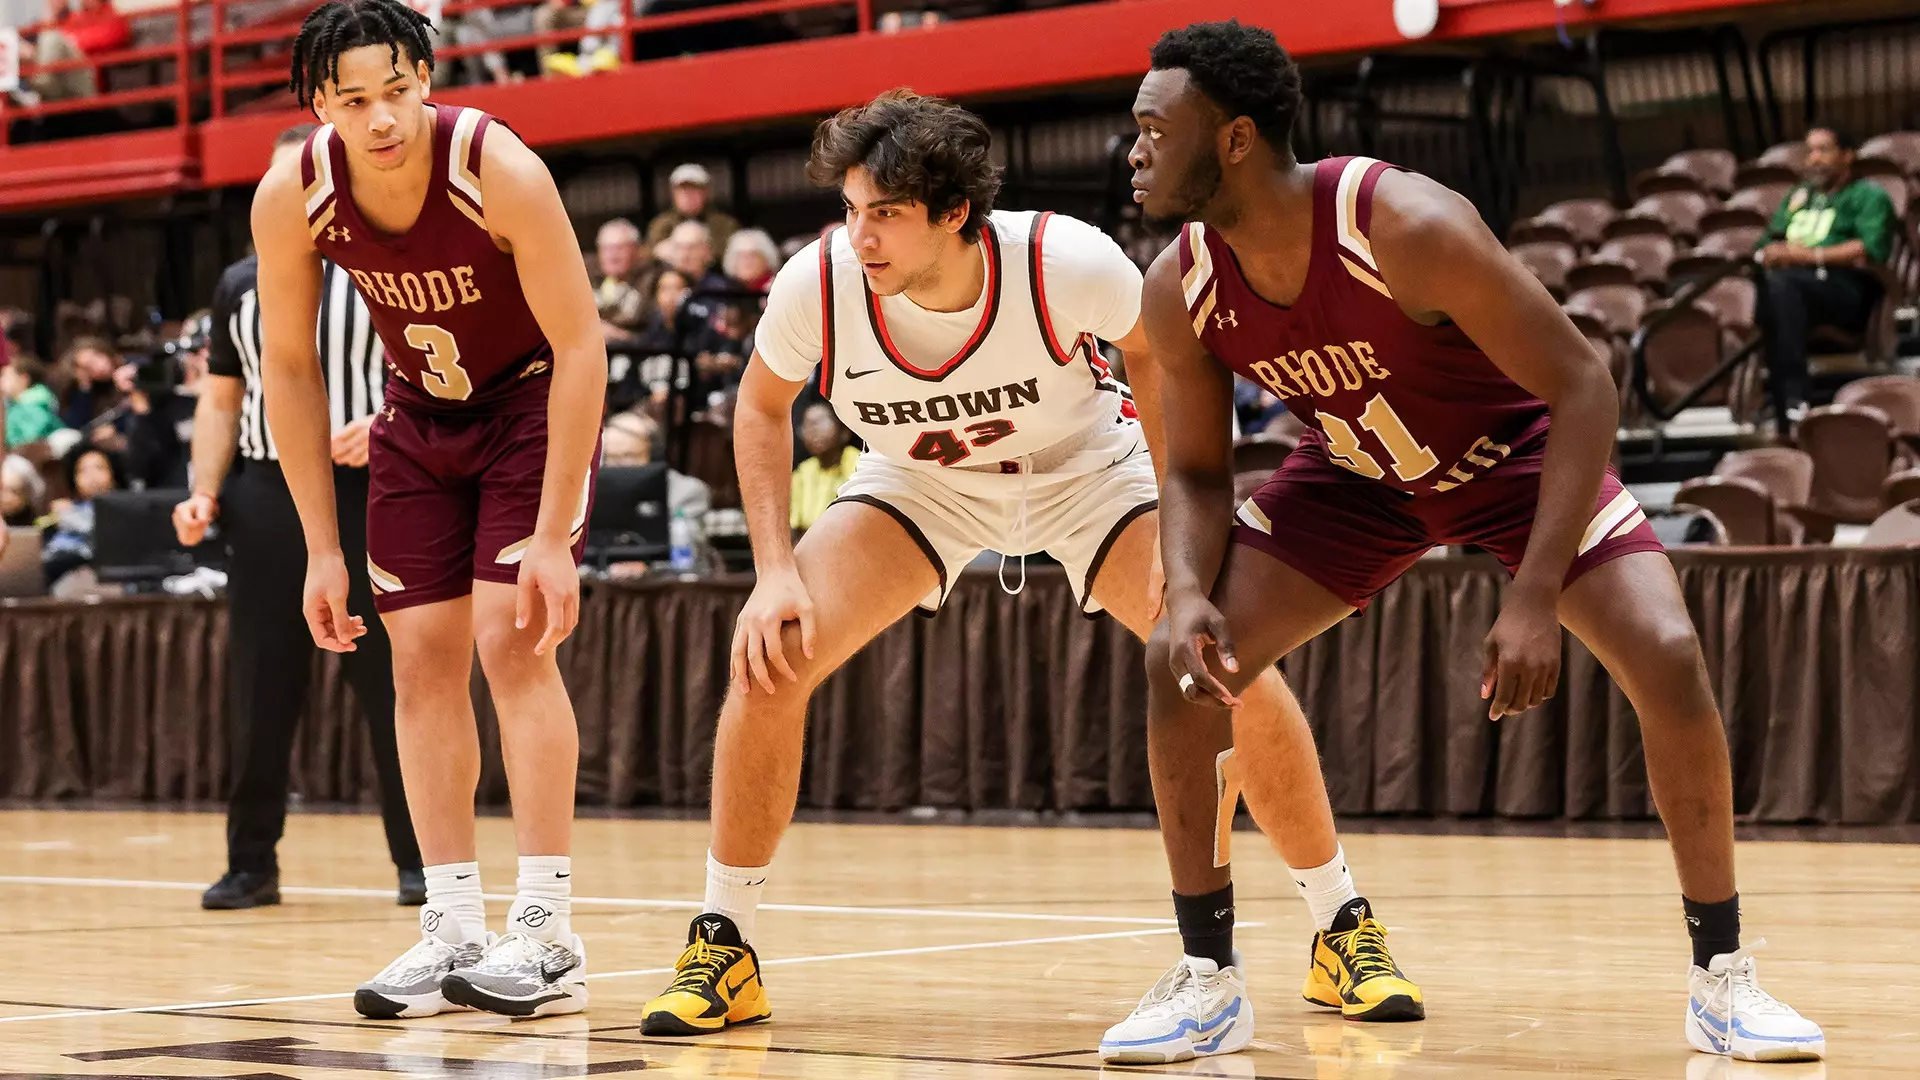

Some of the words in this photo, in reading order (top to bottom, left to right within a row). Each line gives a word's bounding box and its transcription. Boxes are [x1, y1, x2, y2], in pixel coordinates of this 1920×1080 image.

[349, 265, 482, 313] RHODE
[403, 323, 473, 401] 3
[1249, 340, 1391, 400] RHODE
[852, 376, 1041, 426] BROWN
[908, 418, 1018, 467] 43
[1315, 392, 1440, 482] 31
